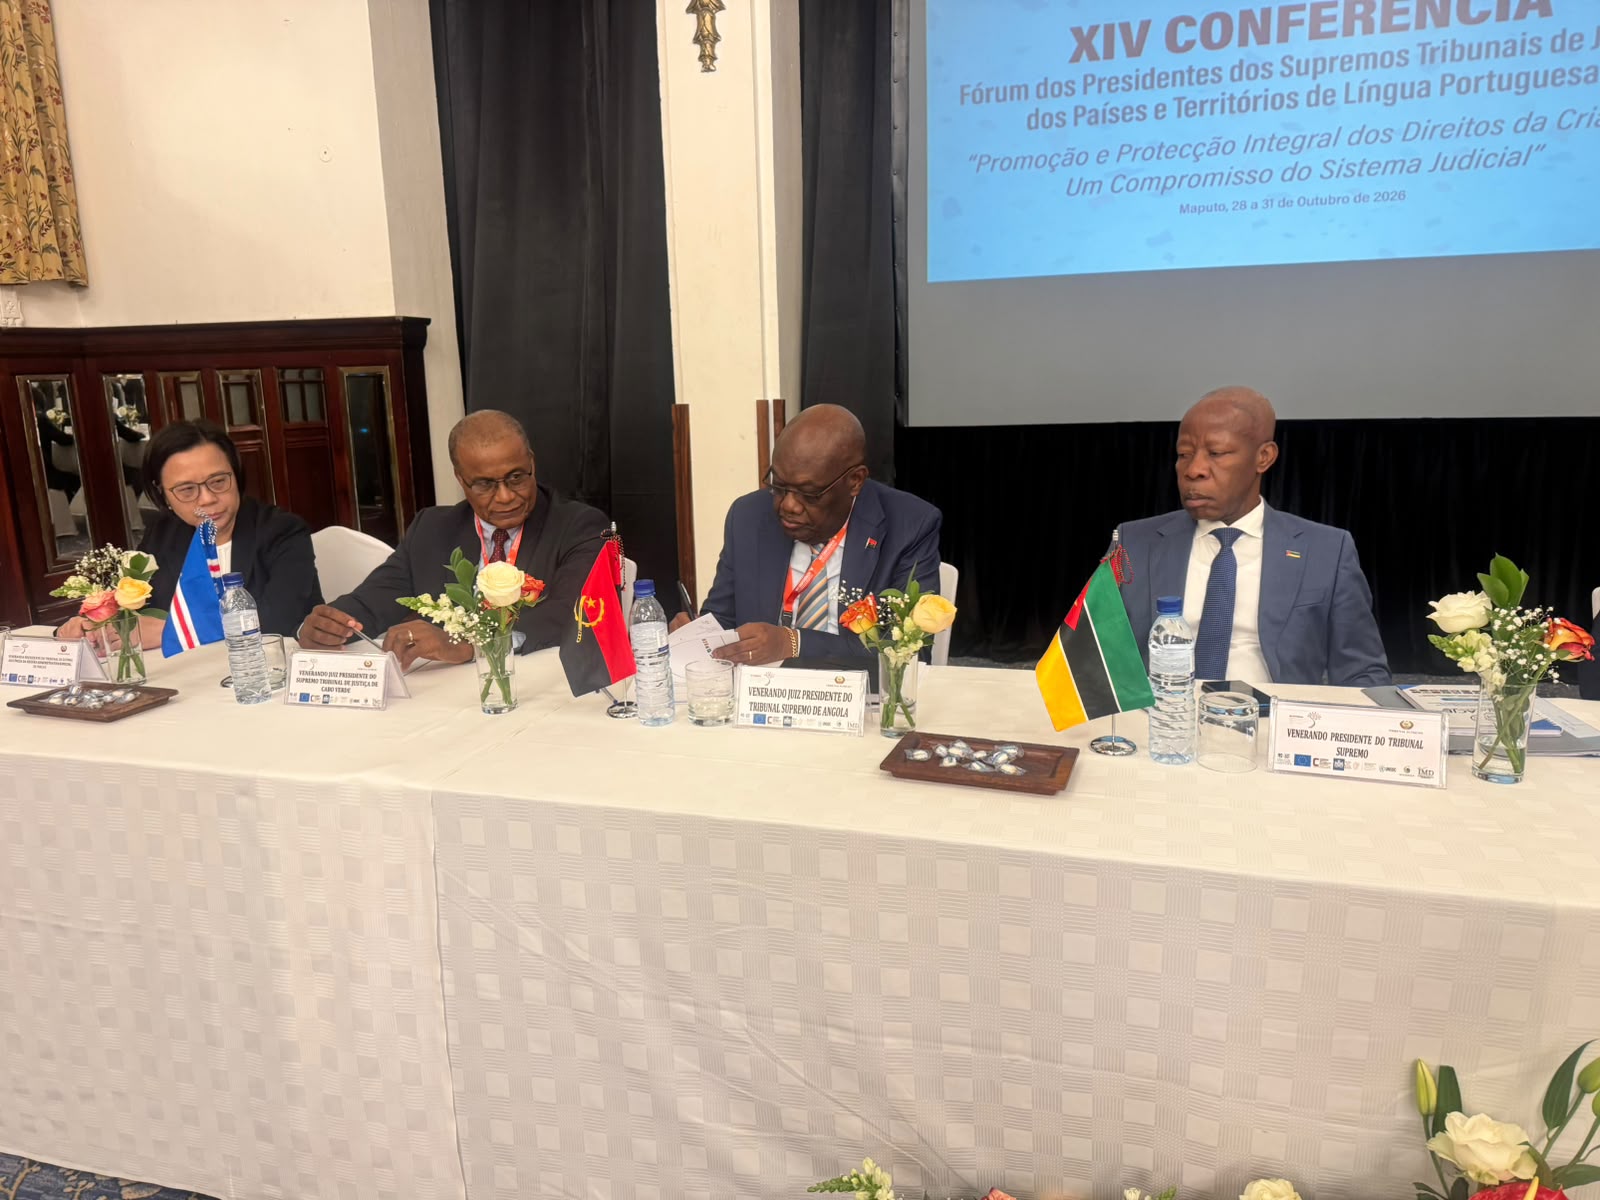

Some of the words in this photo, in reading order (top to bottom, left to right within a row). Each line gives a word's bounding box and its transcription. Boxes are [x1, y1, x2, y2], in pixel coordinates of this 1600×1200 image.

[1068, 19, 1152, 63] XIV
[959, 82, 1029, 105] Fórum
[1035, 77, 1076, 100] dos
[1082, 64, 1222, 95] Presidentes
[1229, 59, 1273, 82] dos
[1280, 47, 1409, 81] Supremos
[1417, 31, 1542, 65] Tribunais
[1550, 28, 1584, 53] de
[1026, 108, 1067, 130] dos
[1073, 101, 1148, 127] Países
[1154, 102, 1167, 120] e
[1173, 88, 1299, 119] Territórios
[1306, 83, 1336, 108] de
[1344, 79, 1431, 106] Língua
[1439, 64, 1599, 96] Portuguesa
[1096, 149, 1109, 165] e
[1116, 136, 1235, 163] Protecção
[1243, 126, 1342, 156] Integral
[1347, 124, 1393, 146] dos
[1402, 118, 1504, 143] Direitos
[1513, 111, 1548, 134] da
[1066, 176, 1102, 197] Um
[1110, 165, 1273, 195] Compromisso
[1280, 162, 1312, 184] do
[1320, 157, 1421, 180] Sistema
[1179, 202, 1229, 216] Maputo,
[1231, 200, 1247, 212] 28
[1250, 202, 1258, 210] a
[1262, 198, 1274, 210] 31
[1277, 196, 1294, 209] de
[1297, 194, 1350, 208] Outubro
[1353, 193, 1370, 205] de
[1373, 190, 1407, 202] 2026
[748, 686, 787, 699] VENERANDO
[787, 688, 801, 700] JUIZ
[801, 690, 842, 702] PRESIDENTE
[842, 692, 853, 703] DO
[749, 701, 780, 713] TRIBUNAL
[781, 703, 812, 716] SUPREMO
[812, 705, 822, 716] DE
[822, 706, 849, 718] ANGOLA
[1286, 728, 1328, 741] VENERANDO
[1330, 734, 1372, 746] PRESIDENTE
[1375, 736, 1386, 746] DO
[1388, 737, 1424, 750] TRIBUNAL
[1335, 746, 1369, 759] SUPREMO
